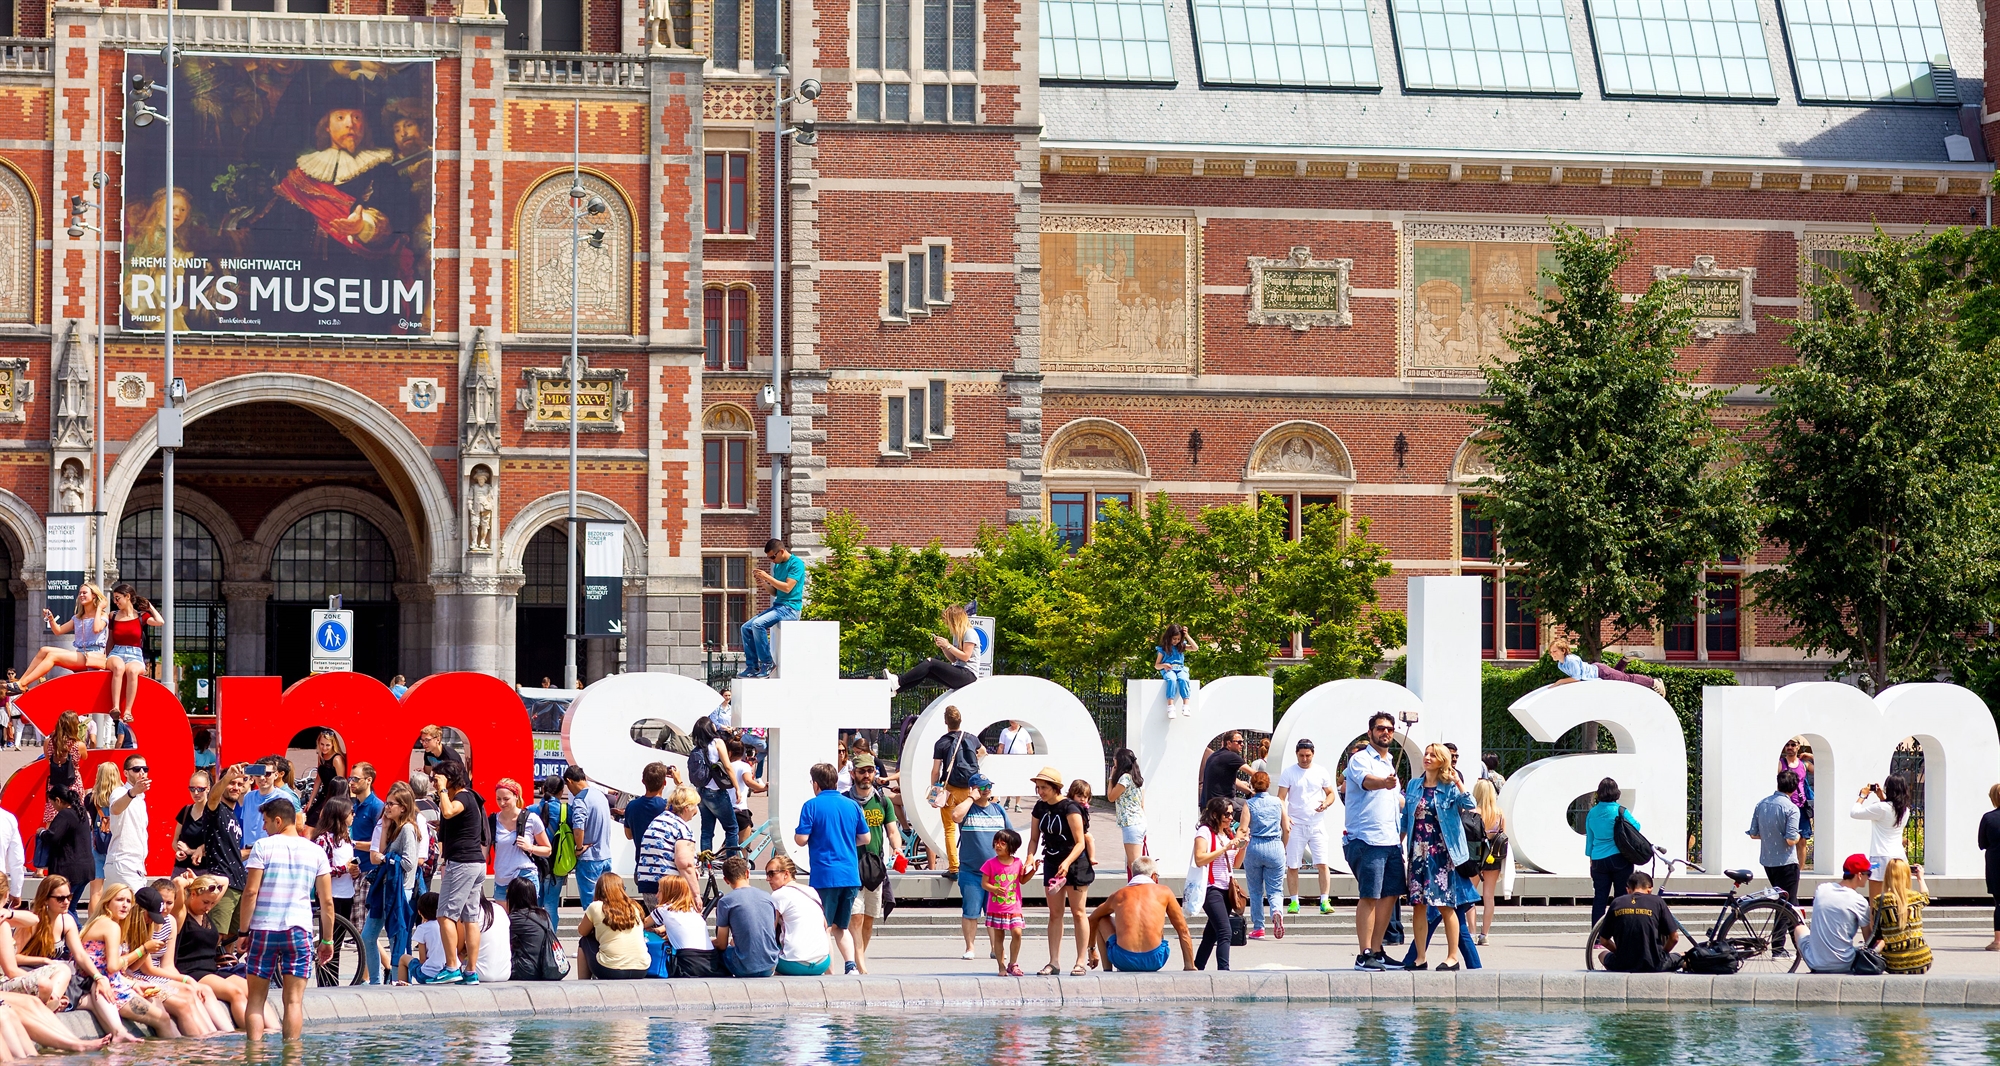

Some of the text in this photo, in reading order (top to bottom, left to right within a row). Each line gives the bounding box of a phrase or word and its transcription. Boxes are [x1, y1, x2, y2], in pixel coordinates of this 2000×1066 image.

[220, 258, 301, 271] #NIGHTWATCH
[250, 276, 424, 315] MUSEUM
[131, 315, 162, 323] PHILIPS
[410, 321, 423, 329] kpn
[544, 739, 560, 750] BIKE
[541, 763, 559, 777] BIKE
